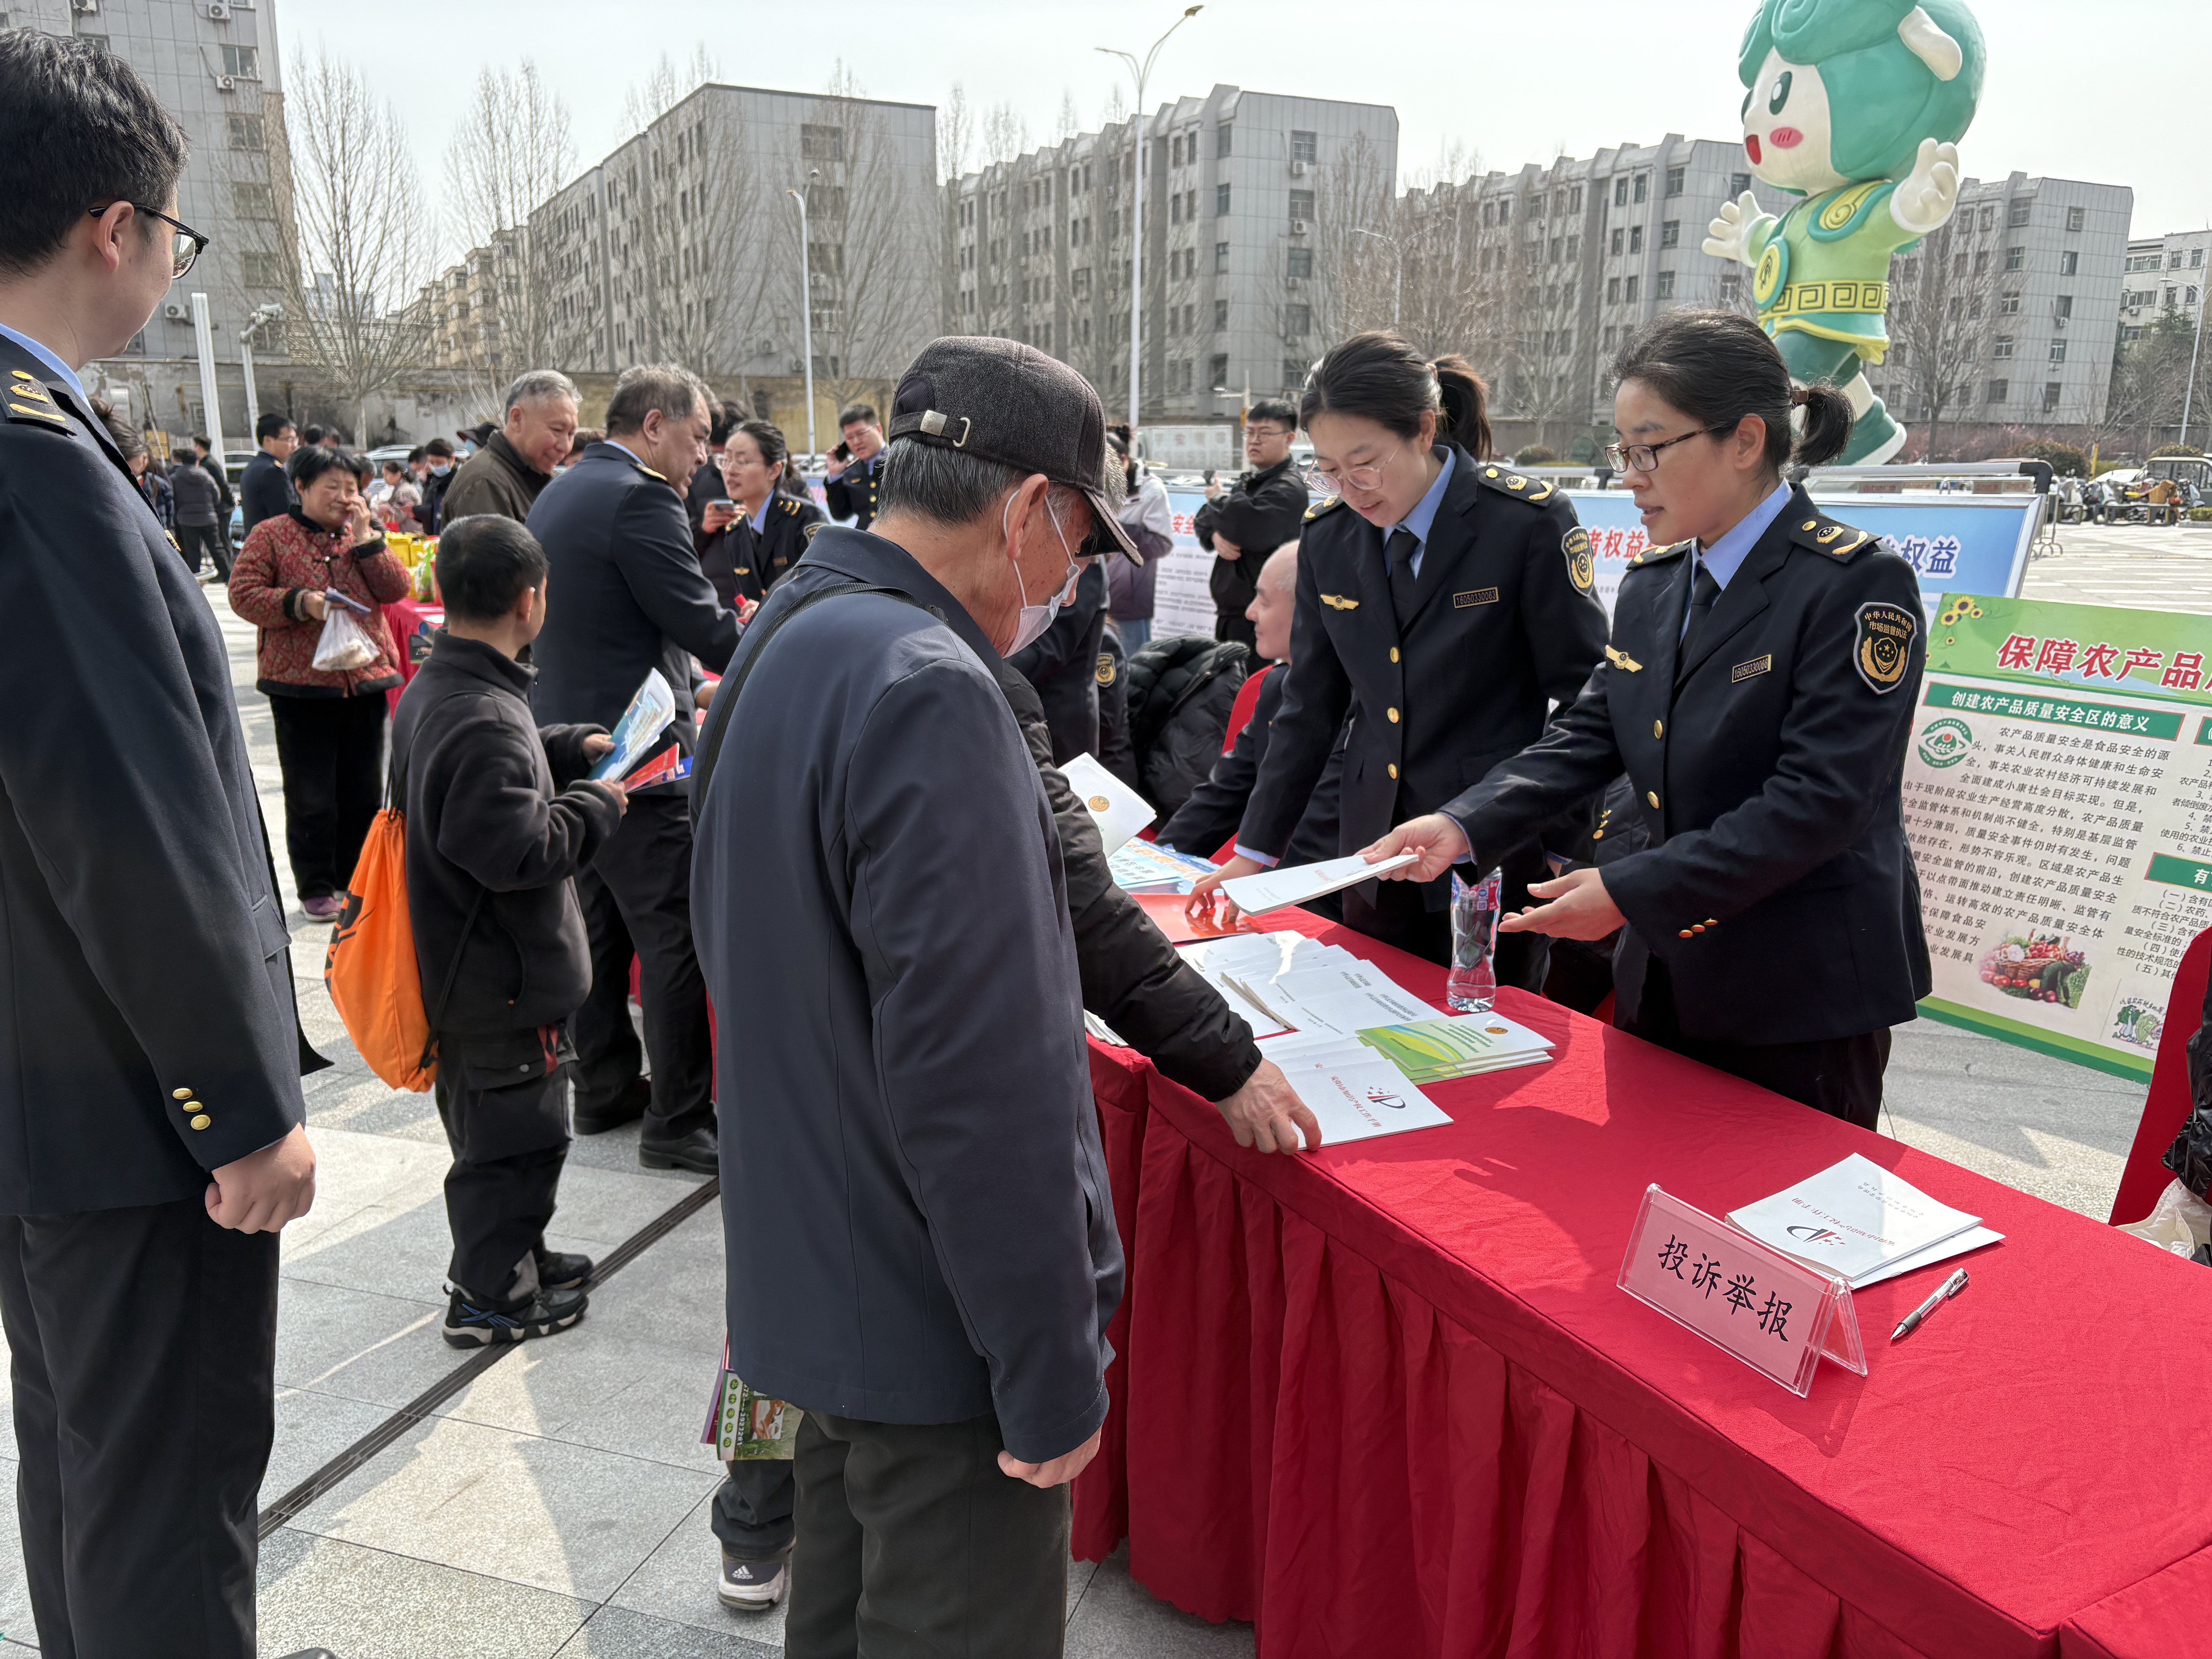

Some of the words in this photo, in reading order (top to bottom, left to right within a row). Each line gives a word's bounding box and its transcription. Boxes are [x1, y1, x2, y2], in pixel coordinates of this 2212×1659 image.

[1589, 529, 1654, 558] 者权益
[1886, 539, 1957, 574] 权益
[1865, 611, 1912, 632] 中华人民共和国
[1870, 621, 1907, 639] 市场监管执法
[1952, 691, 2150, 732] 创建农产品质量安全区的意义
[1972, 740, 2164, 778] 头，事关人民群众身体健康和生命安
[1999, 726, 2171, 761] 农产品质量安全是食品安全的源
[1960, 773, 2143, 814] 全面建成小康社会目标实现。但是，
[1965, 756, 2157, 796] 全，事关农业农村经济可持续发展和
[1903, 780, 2144, 833] 由于现阶段农业生产经营高度分散，农产品质量
[2196, 790, 2212, 801] 3、
[2185, 822, 2212, 835] 5、禁
[2177, 843, 2212, 858] 6、禁止
[2194, 869, 2212, 887] 有
[1920, 887, 2105, 939] 格、运转高效的农产品质量安全体
[2131, 905, 2212, 929] 质不符合农产品质
[1658, 1234, 1793, 1342] 投诉举报
